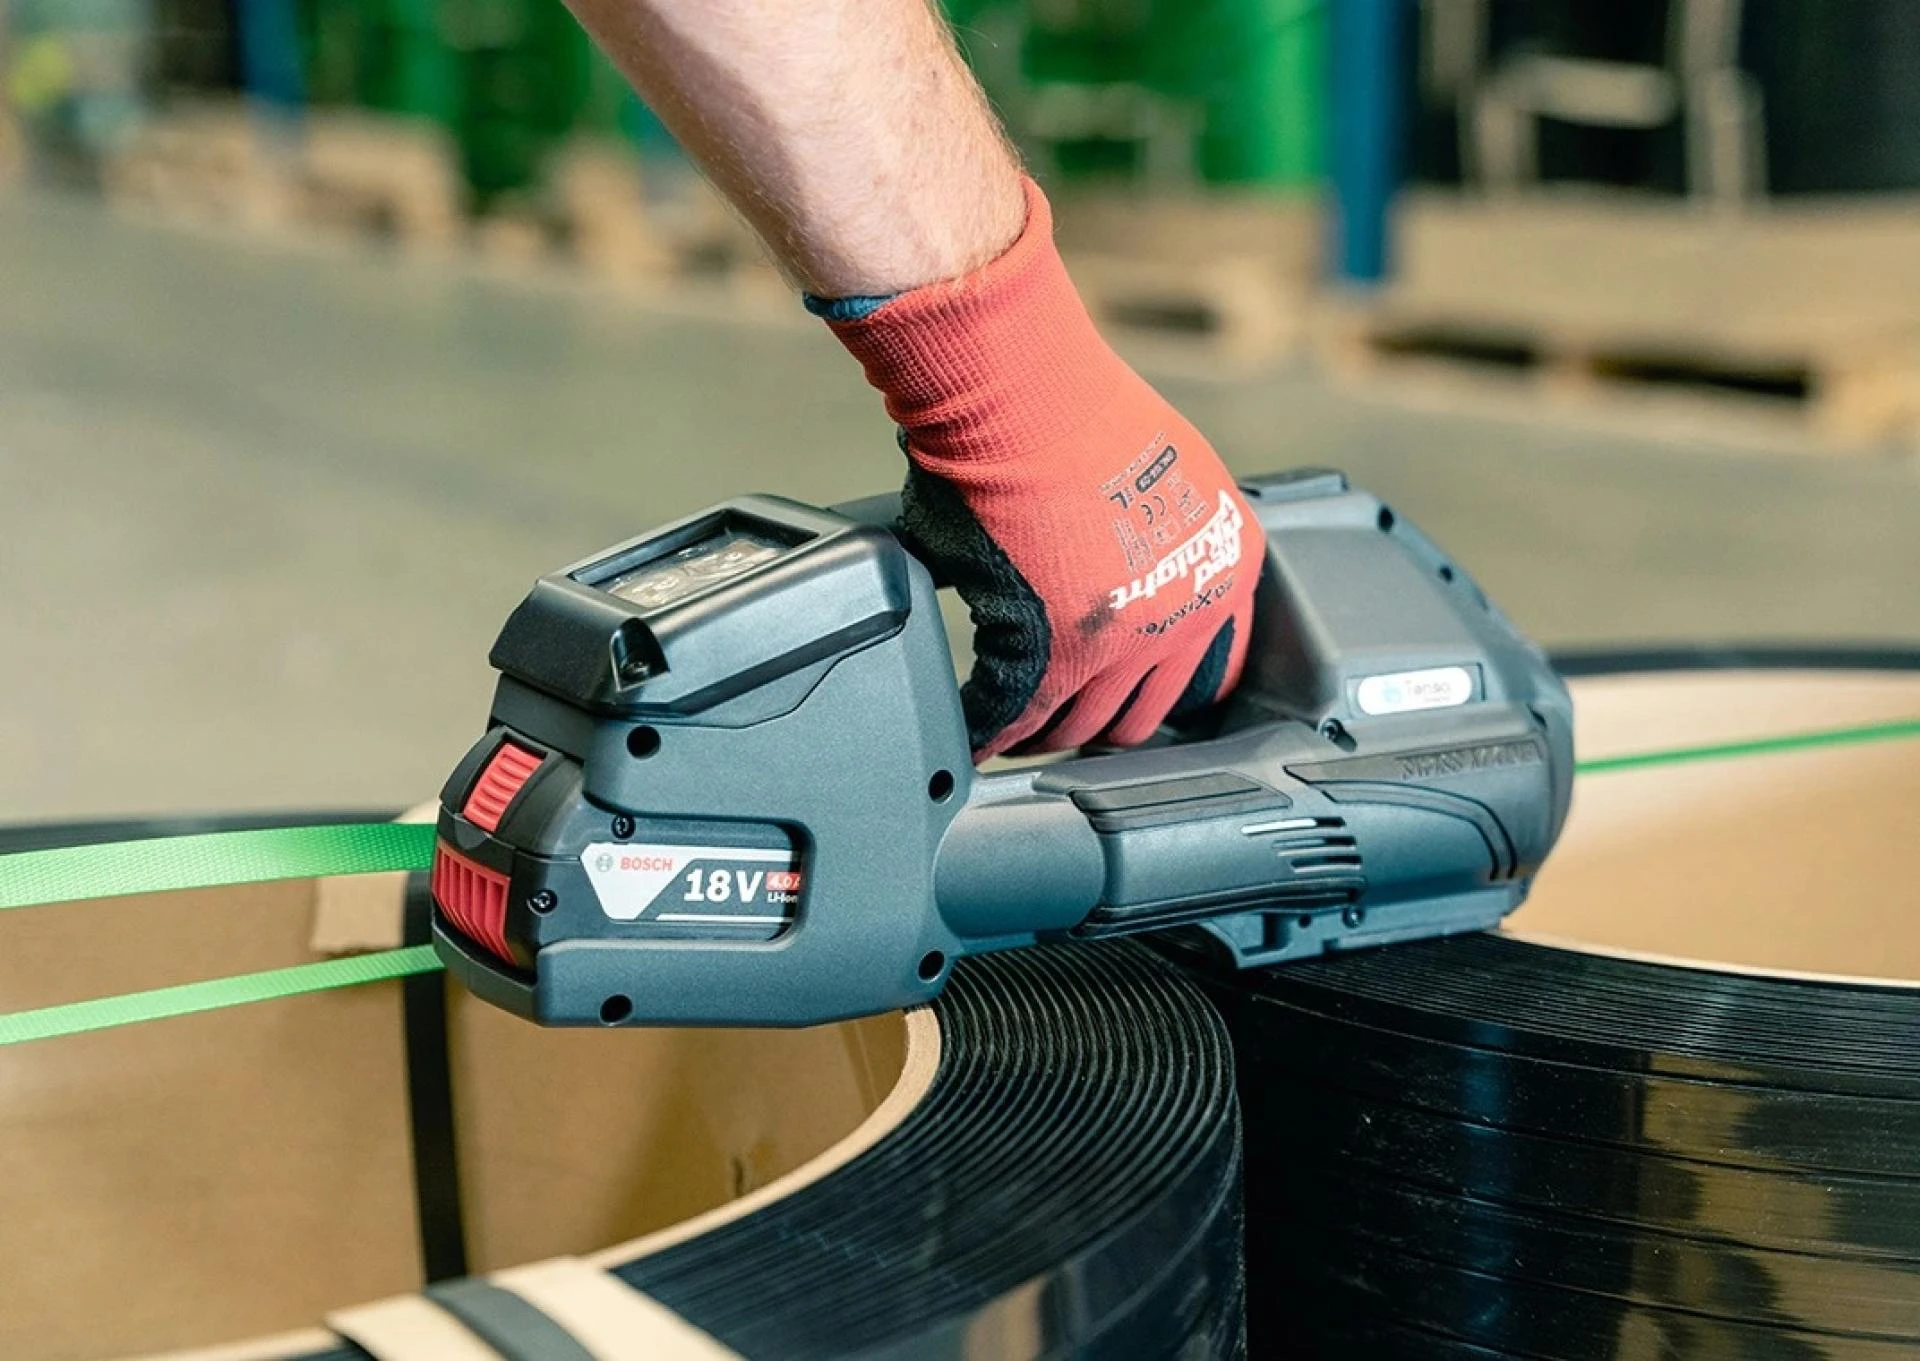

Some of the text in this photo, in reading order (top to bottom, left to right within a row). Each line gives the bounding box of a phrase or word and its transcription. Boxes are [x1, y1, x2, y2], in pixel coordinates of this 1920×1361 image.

[1108, 520, 1224, 609] Knight
[620, 857, 673, 872] BOSCH
[683, 868, 764, 903] 18V
